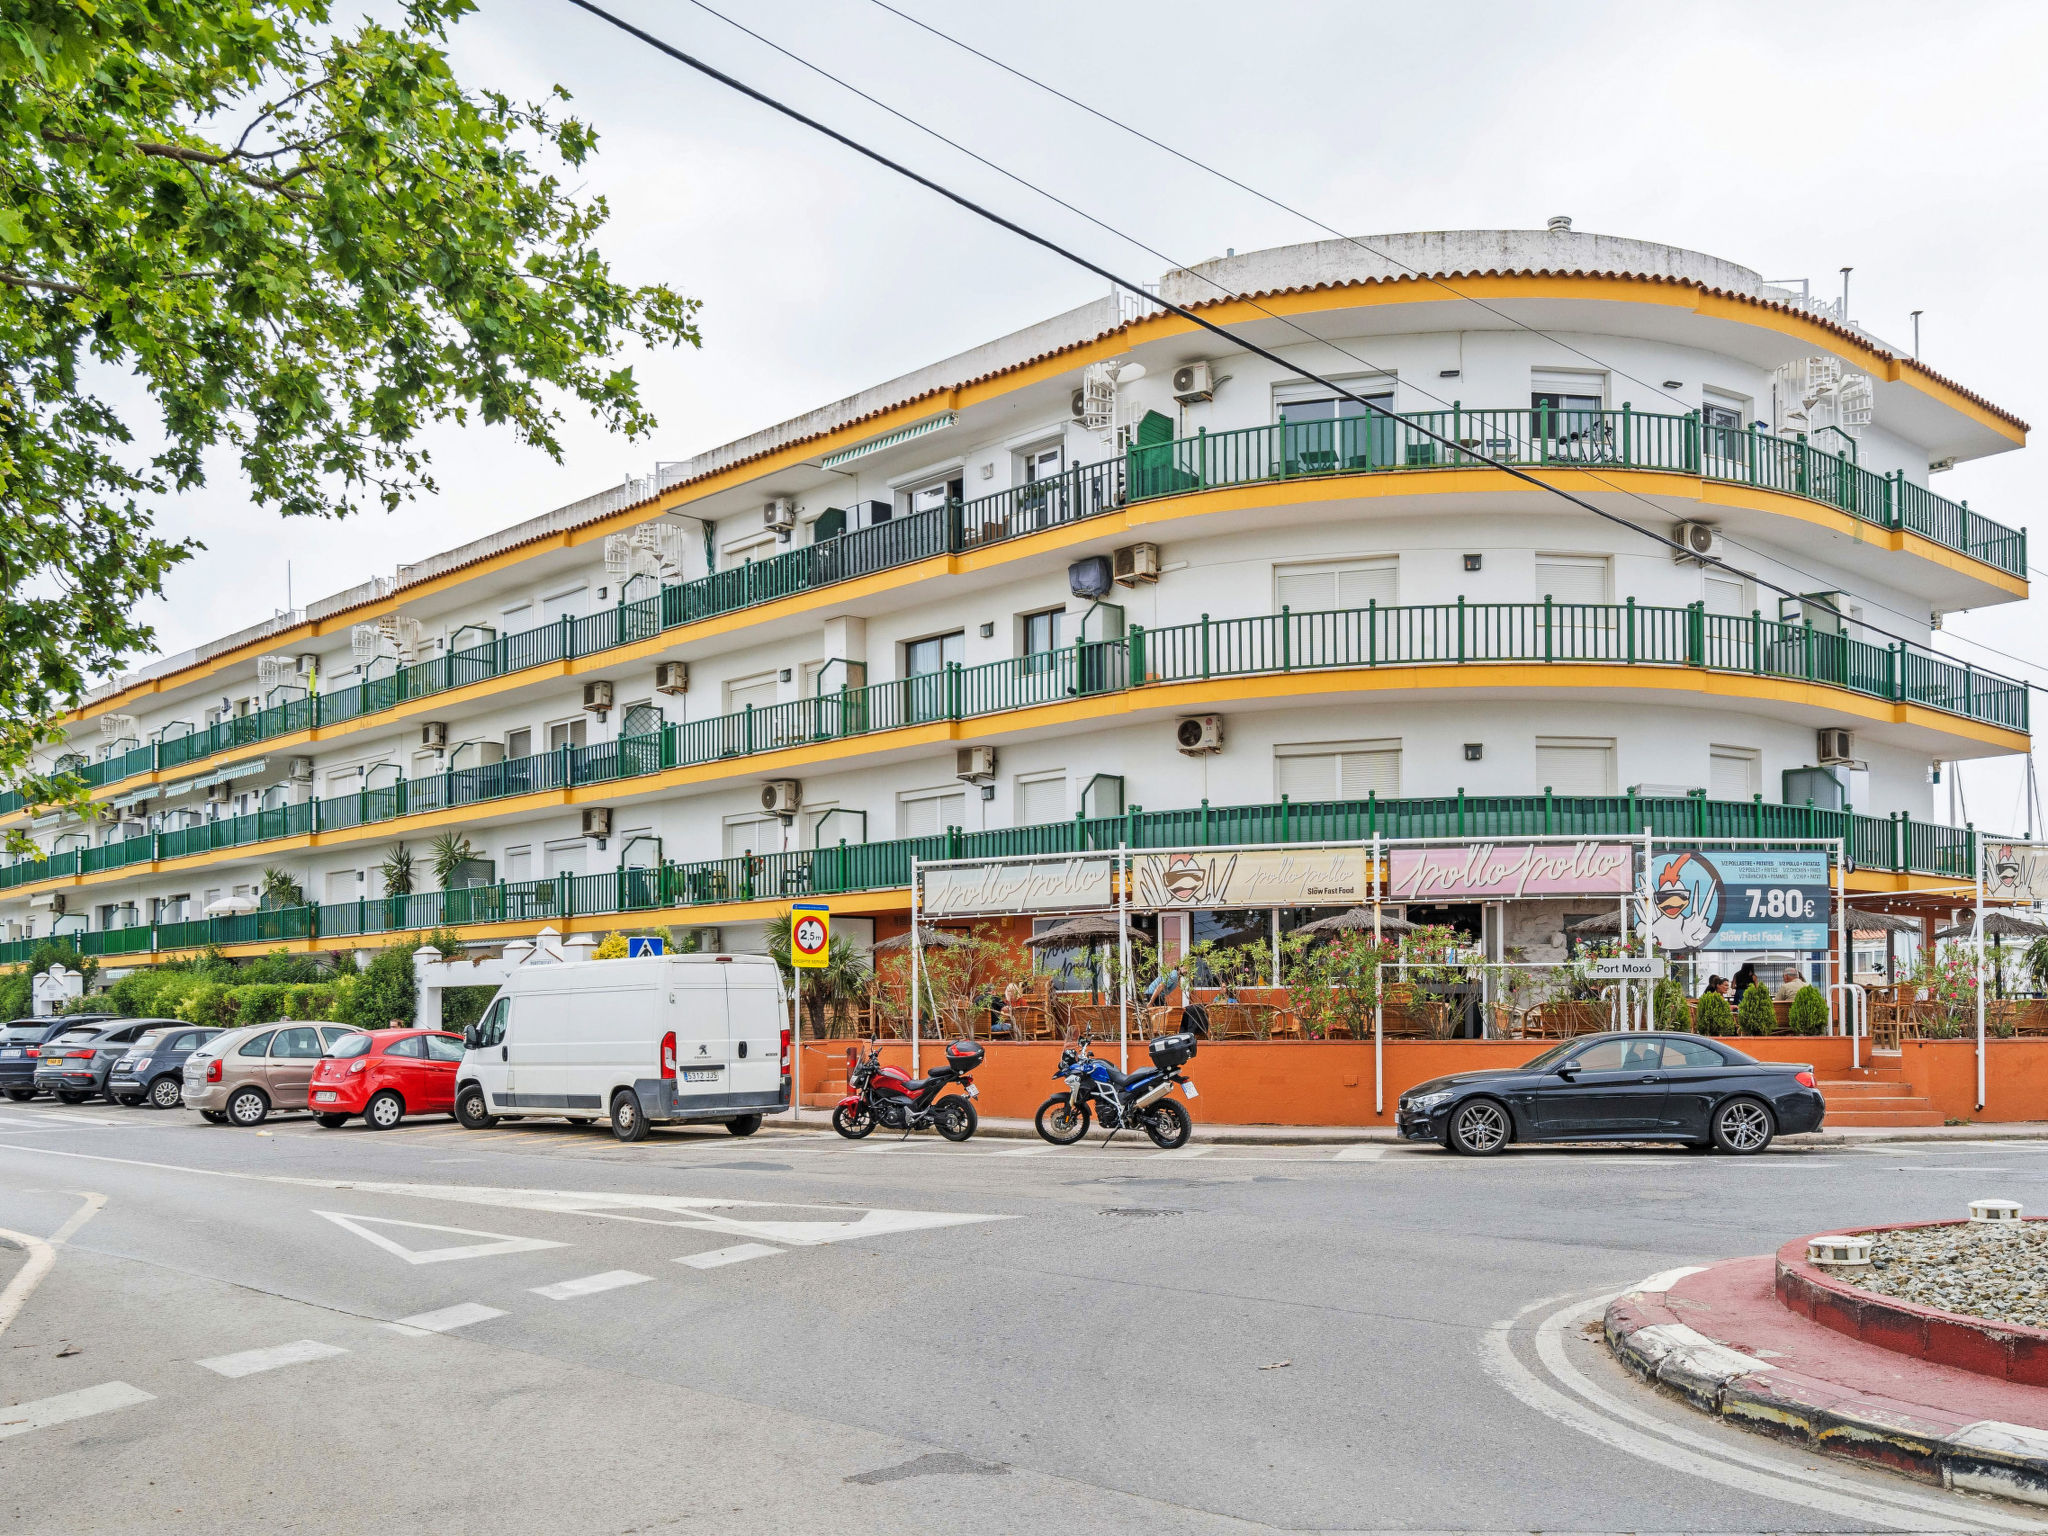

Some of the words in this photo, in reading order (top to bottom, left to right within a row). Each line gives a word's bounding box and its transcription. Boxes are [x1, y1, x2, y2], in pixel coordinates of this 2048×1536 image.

[1324, 887, 1338, 895] Fast
[1338, 886, 1355, 894] Food
[1743, 930, 1761, 942] Fast
[1762, 931, 1784, 942] Food
[1596, 964, 1619, 973] Port
[1622, 963, 1652, 973] Moxó
